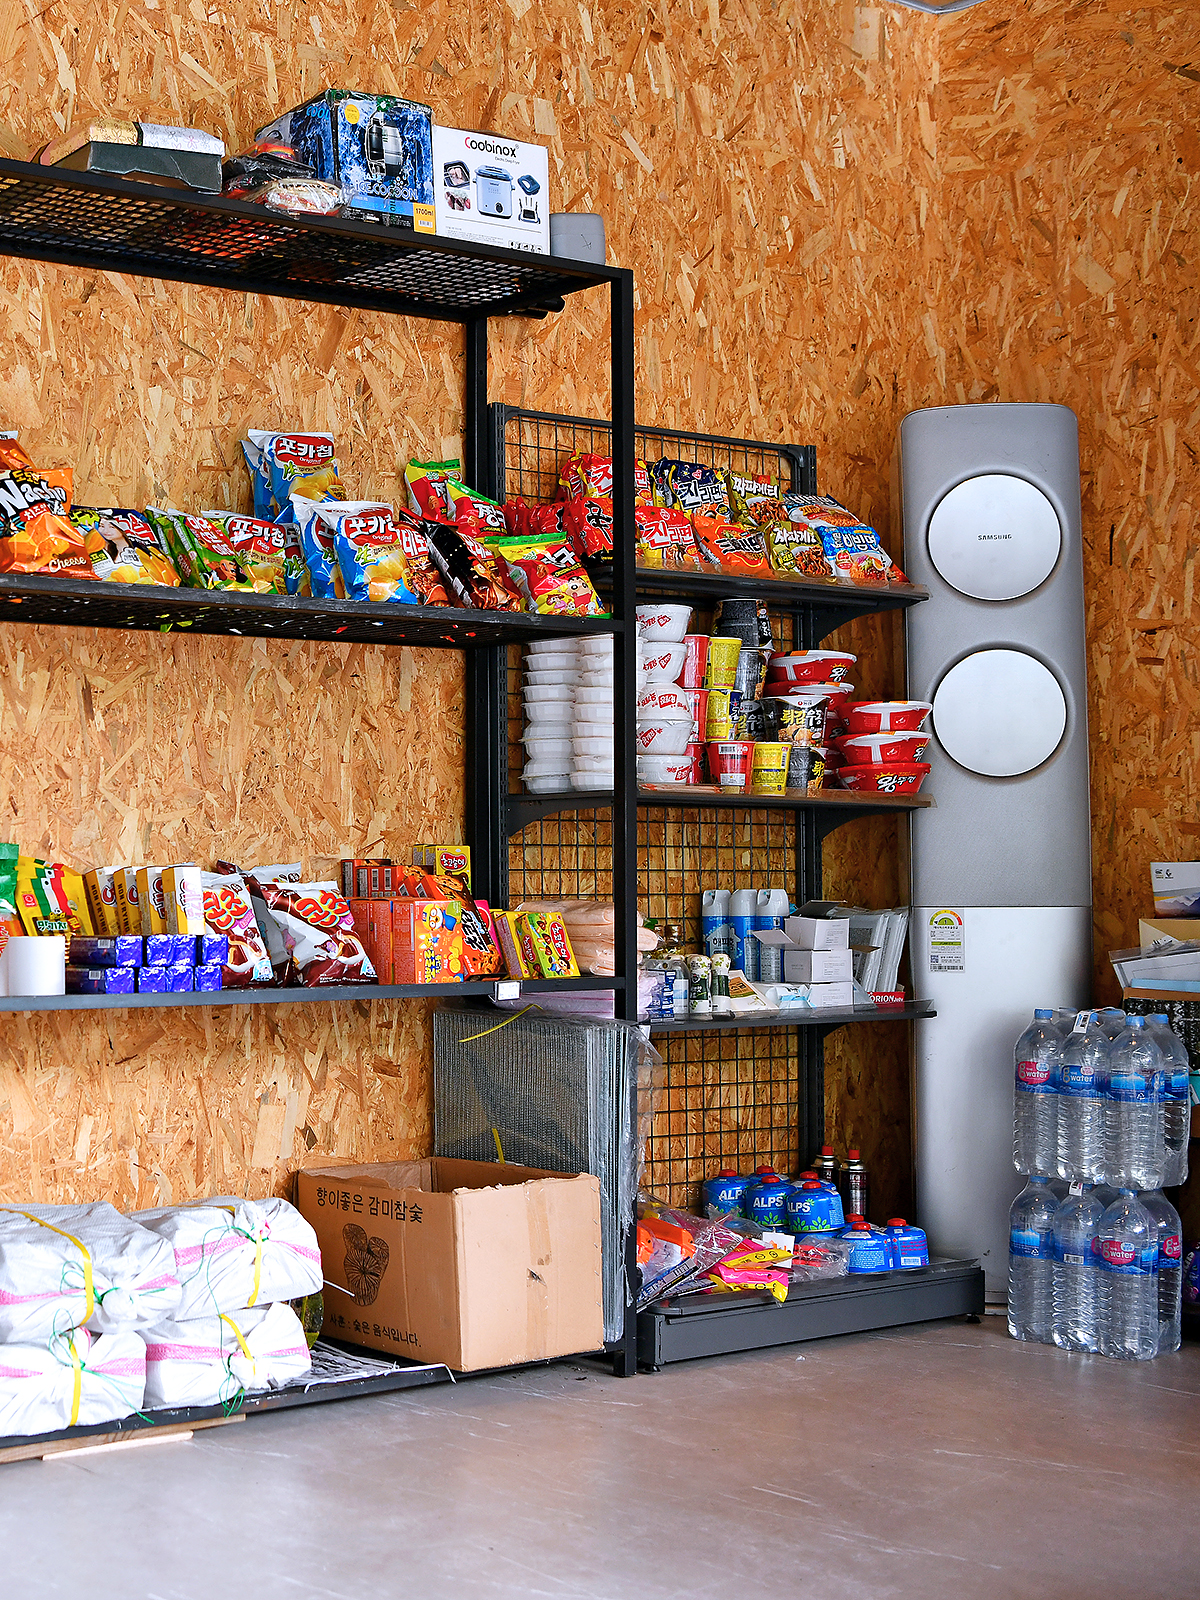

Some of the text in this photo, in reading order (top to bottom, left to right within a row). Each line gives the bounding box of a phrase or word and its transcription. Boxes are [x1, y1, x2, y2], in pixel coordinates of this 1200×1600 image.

[465, 137, 517, 158] Coobinox
[416, 207, 434, 217] 1700ml
[277, 437, 334, 461] 포카칩
[678, 480, 725, 510] 진라면
[731, 475, 779, 499] 짜파게티
[642, 520, 695, 549] 진라면
[49, 556, 87, 573] Cheese
[781, 709, 823, 728] 튀김우동
[441, 853, 466, 869] 초코송이
[90, 884, 108, 933] NON FRYING
[117, 883, 131, 933] NON FRYING
[551, 922, 569, 959] 초코송이
[870, 995, 894, 1003] ORION
[316, 1186, 424, 1223] 향이좋은 감미참숯
[753, 1196, 784, 1208] ALPS
[1110, 1251, 1133, 1259] water
[353, 1319, 371, 1335] 숯은
[372, 1325, 422, 1348] 음식입니다.
